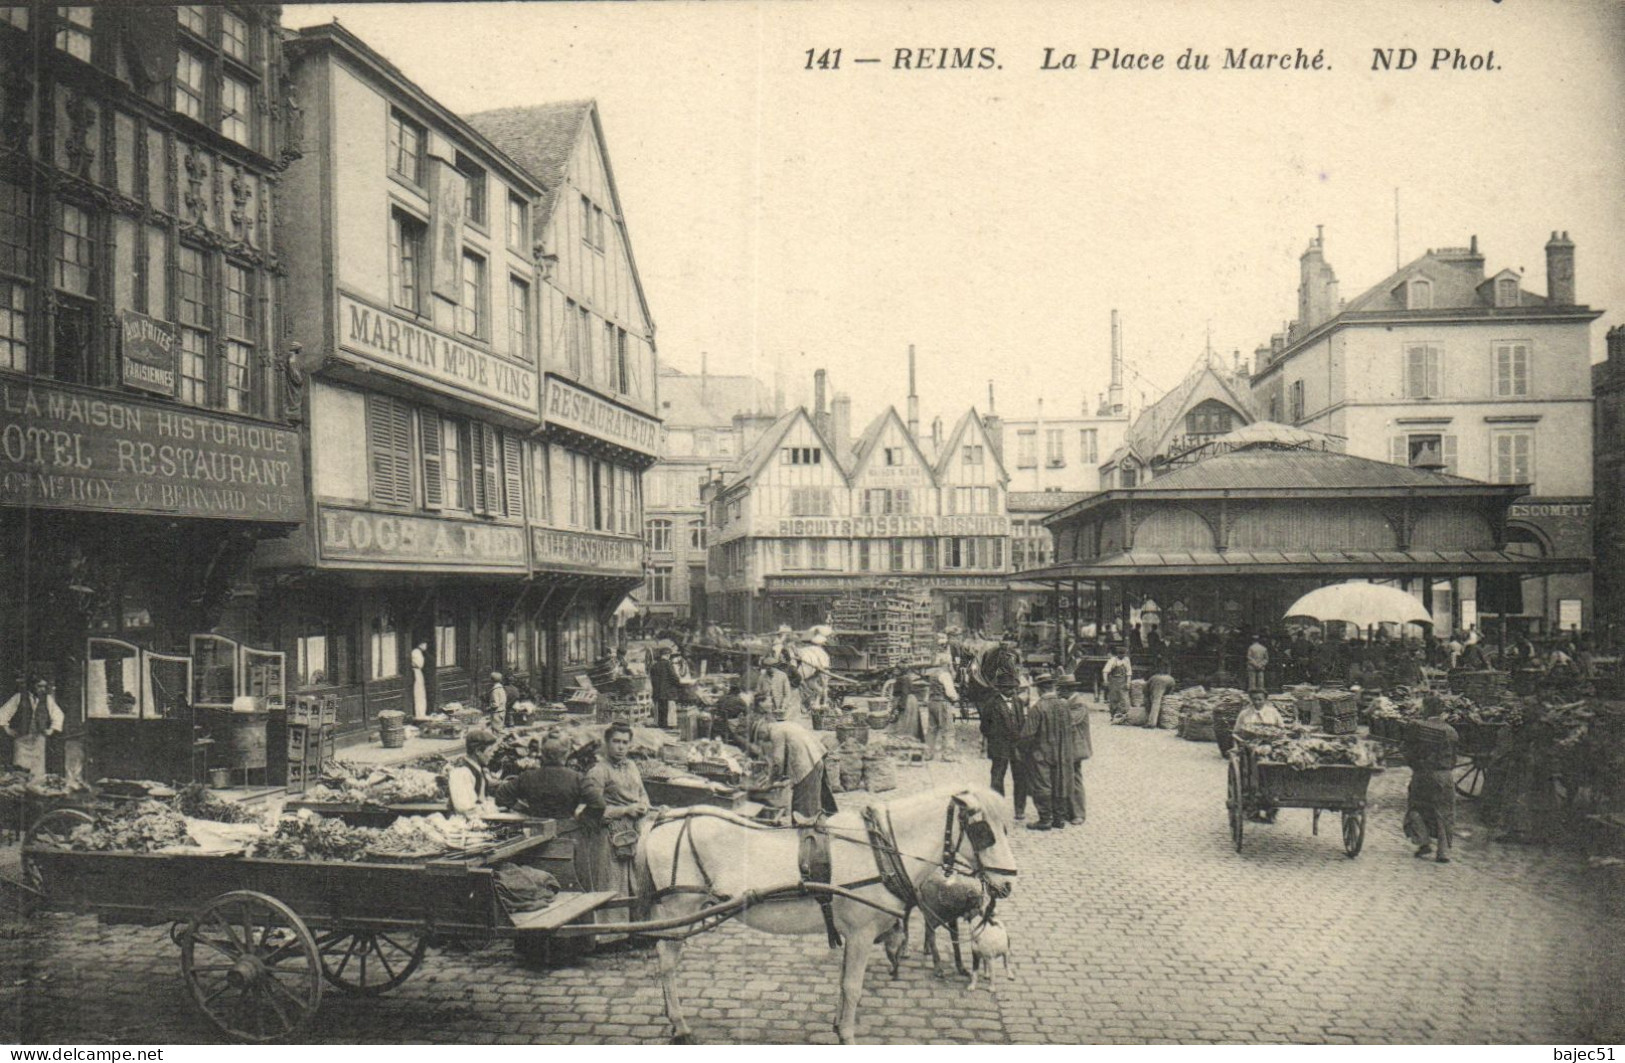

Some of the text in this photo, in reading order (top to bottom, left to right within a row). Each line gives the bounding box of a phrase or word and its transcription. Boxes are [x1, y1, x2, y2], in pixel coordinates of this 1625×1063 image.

[140, 318, 173, 353] FRITES
[349, 303, 438, 369] MARTIN
[467, 355, 489, 386] DE
[493, 360, 532, 402] VINS
[124, 357, 174, 388] PARISIENNES
[3, 384, 288, 454] LA MAISON HISTORIQUE
[549, 383, 658, 451] RESTAURATEUR
[115, 438, 291, 488] RESTAURANT
[70, 477, 121, 505] ROY
[160, 483, 247, 512] BERNARD
[1511, 504, 1592, 517] ESCOMPTE
[433, 522, 455, 556] A
[778, 519, 851, 536] BISCUITS
[853, 516, 936, 536] FOSSIER
